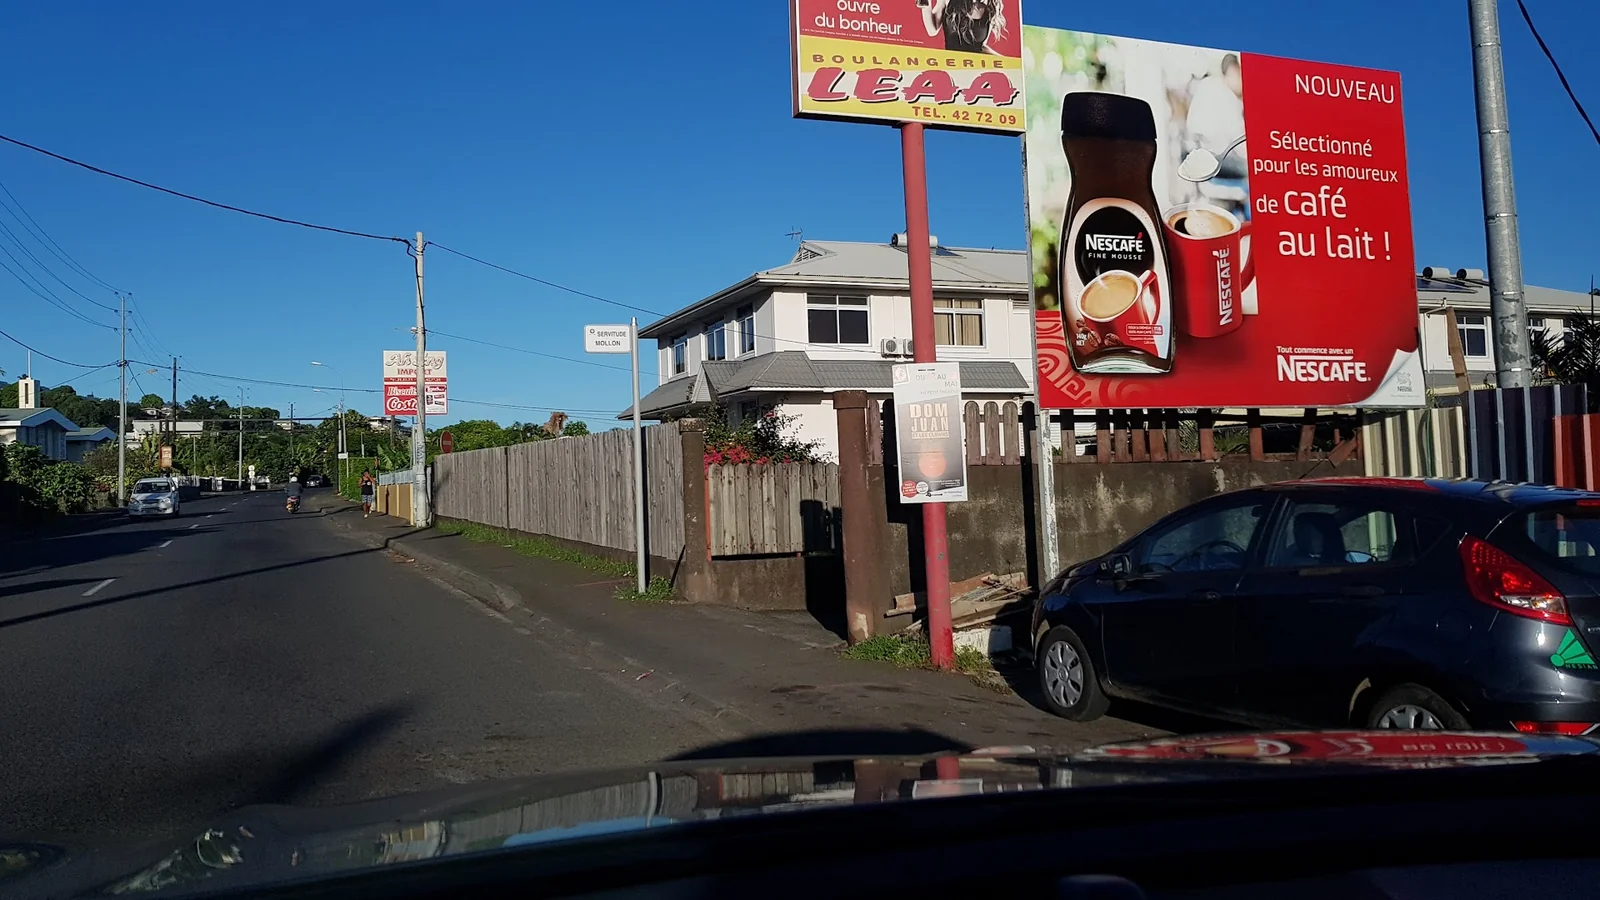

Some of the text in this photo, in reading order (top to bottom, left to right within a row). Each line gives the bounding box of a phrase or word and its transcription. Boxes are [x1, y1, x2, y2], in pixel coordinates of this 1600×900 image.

[837, 0, 880, 14] ouvre
[814, 12, 902, 35] du bonheur
[812, 54, 1004, 69] BOULANGERIE
[807, 66, 1020, 106] LEAA
[1295, 73, 1395, 104] NOUVEAU
[912, 106, 1017, 125] TEL. 42 72 09
[1269, 130, 1373, 157] Sélectionné
[1253, 158, 1398, 183] pour les amoureux
[1256, 185, 1347, 218] de café
[1278, 231, 1316, 257] au
[1325, 226, 1375, 260] lait
[1276, 346, 1293, 354] Tout
[909, 402, 948, 418] DOM
[911, 416, 949, 432] JUAN
